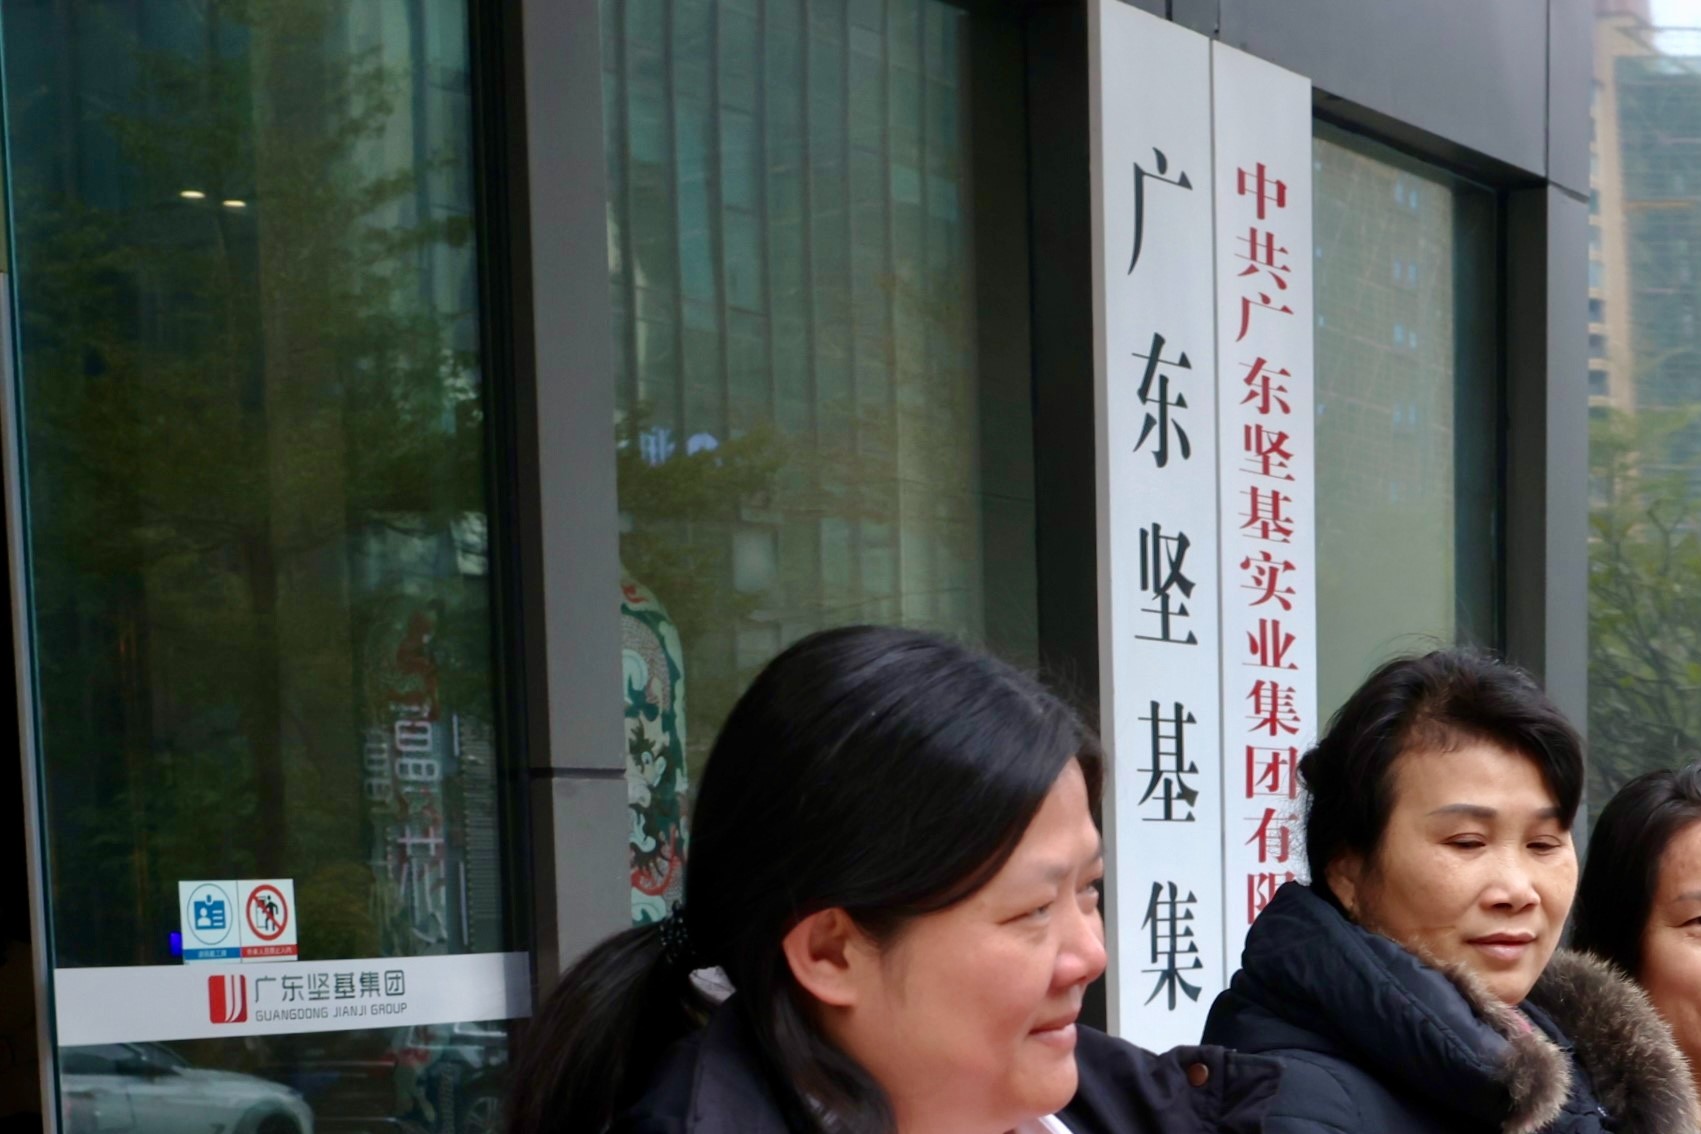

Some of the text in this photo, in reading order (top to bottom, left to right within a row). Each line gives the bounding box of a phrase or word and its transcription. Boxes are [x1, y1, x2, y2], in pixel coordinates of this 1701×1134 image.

[1127, 146, 1204, 1012] 广东坚基集
[255, 969, 406, 1003] 广东坚基集团
[255, 1002, 408, 1022] GUANGDONG JIANJI GROUP
